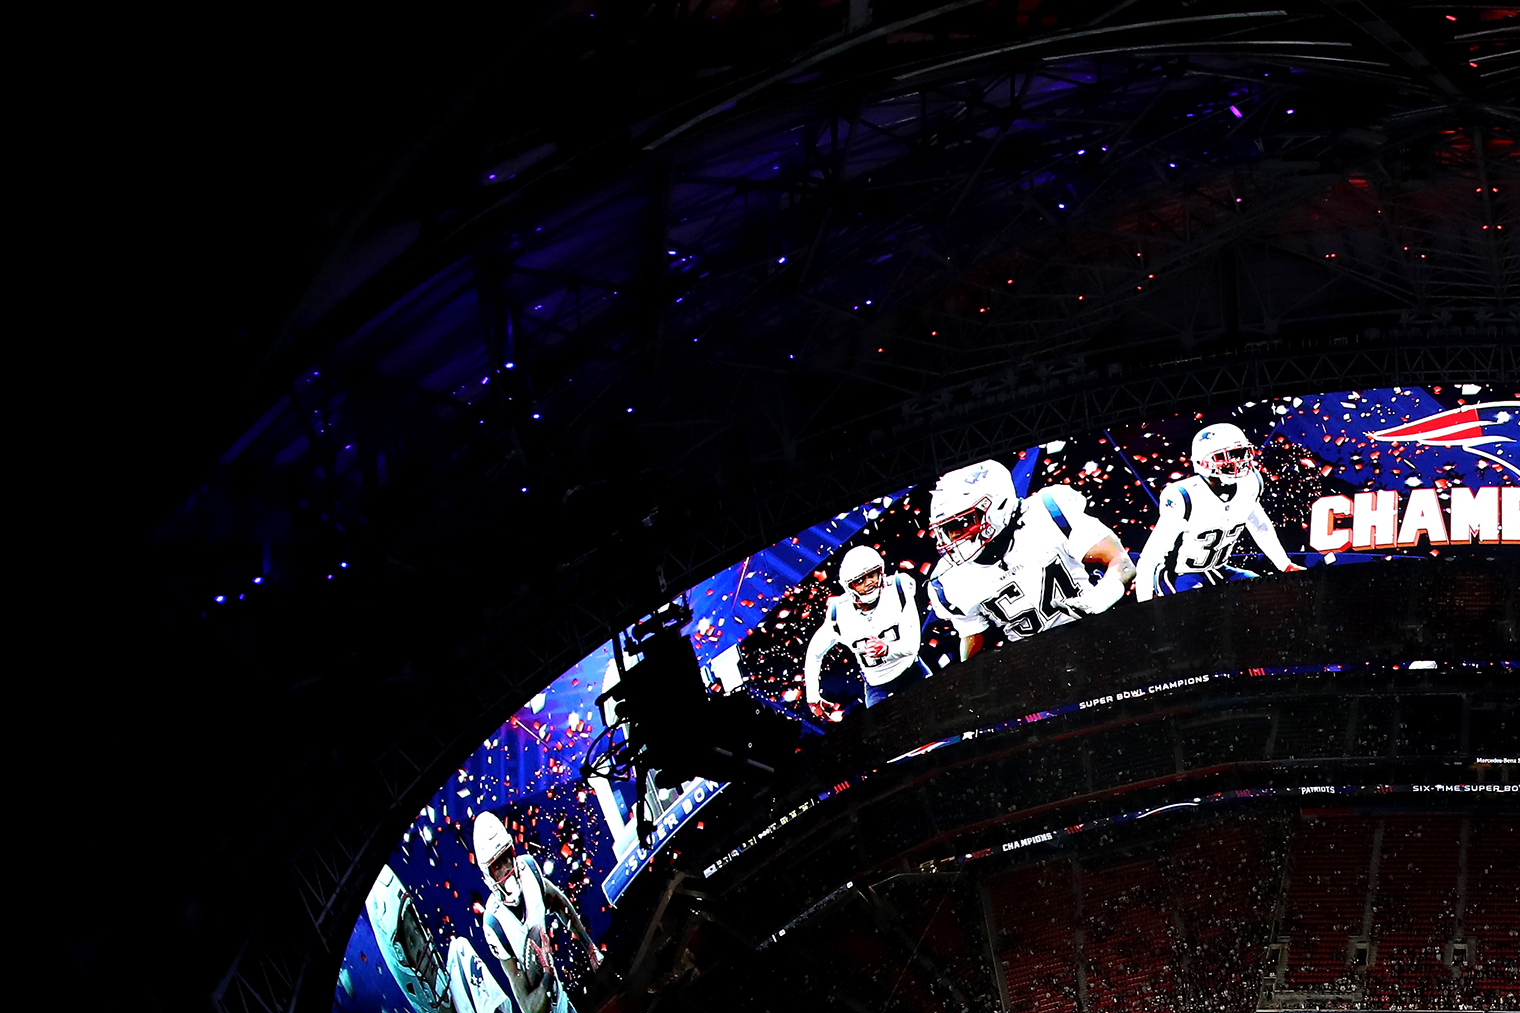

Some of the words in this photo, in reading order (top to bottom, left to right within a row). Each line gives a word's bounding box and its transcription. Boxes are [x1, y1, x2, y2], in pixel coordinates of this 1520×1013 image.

[981, 553, 1083, 638] 54
[1078, 694, 1114, 710] SUPER
[1116, 687, 1146, 701] BOWL
[1147, 674, 1210, 695] CHAMPIONS
[1301, 785, 1335, 796] PATRIOTS
[1412, 784, 1461, 793] SIX-TIME
[1464, 784, 1504, 794] SUPER
[1001, 832, 1053, 853] CHAMPIONS
